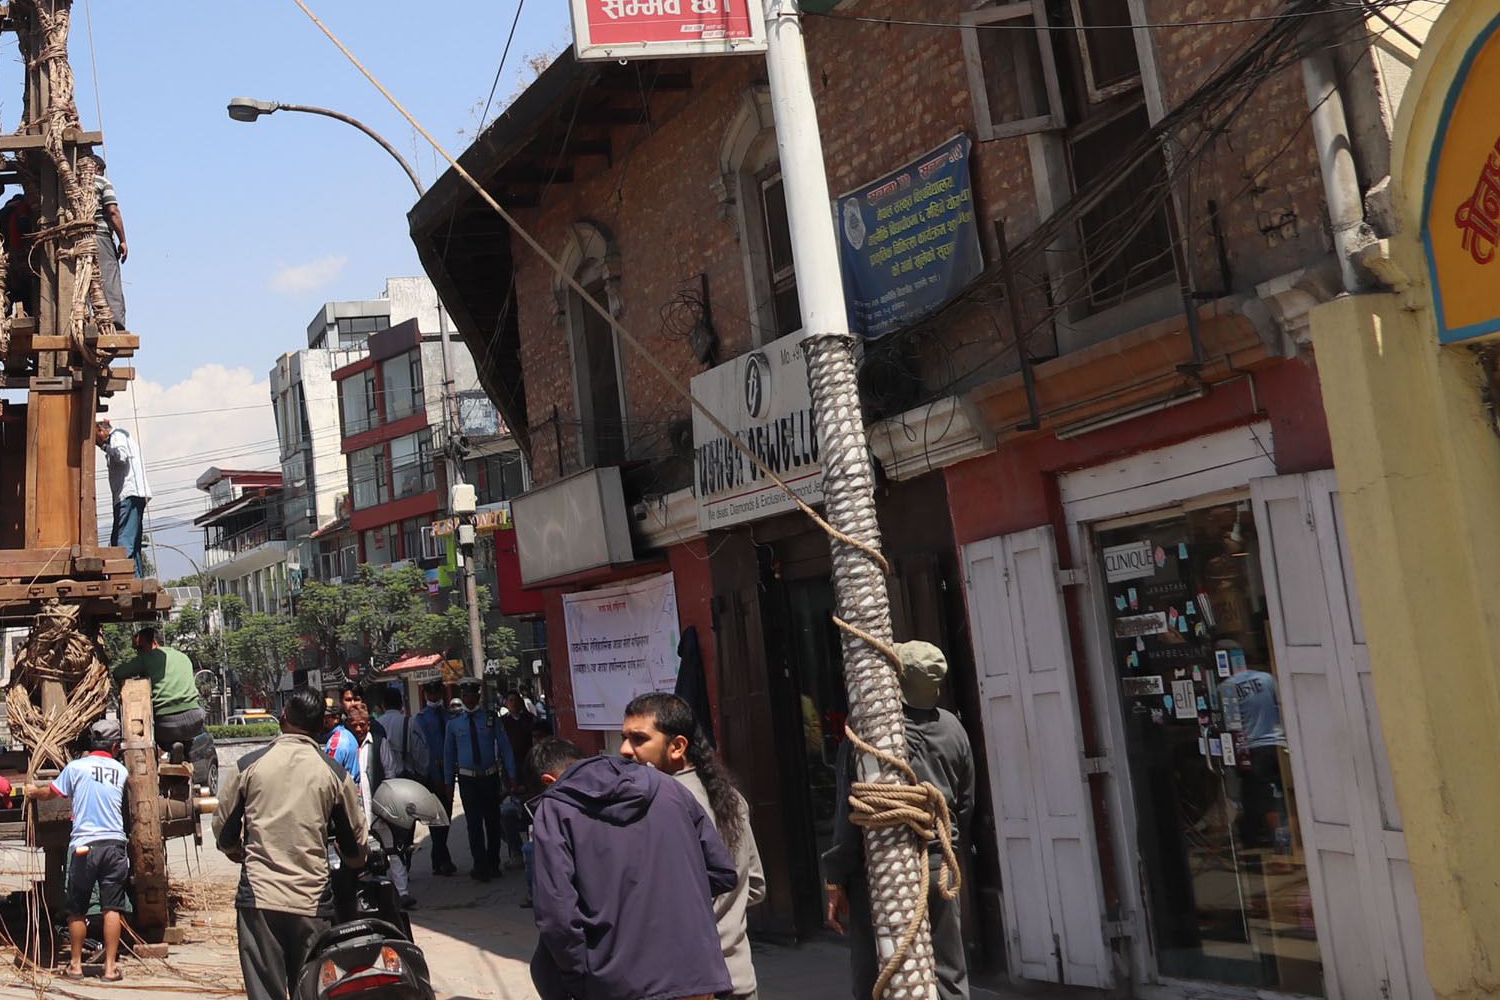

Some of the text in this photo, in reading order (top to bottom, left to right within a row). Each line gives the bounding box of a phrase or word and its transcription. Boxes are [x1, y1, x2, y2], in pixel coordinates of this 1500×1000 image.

[730, 503, 755, 516] Diamonds
[755, 497, 760, 508] &
[761, 492, 786, 508] Exclusive
[1105, 549, 1153, 572] CLINIQUE
[1174, 681, 1193, 710] elf
[340, 924, 367, 935] HONDA
